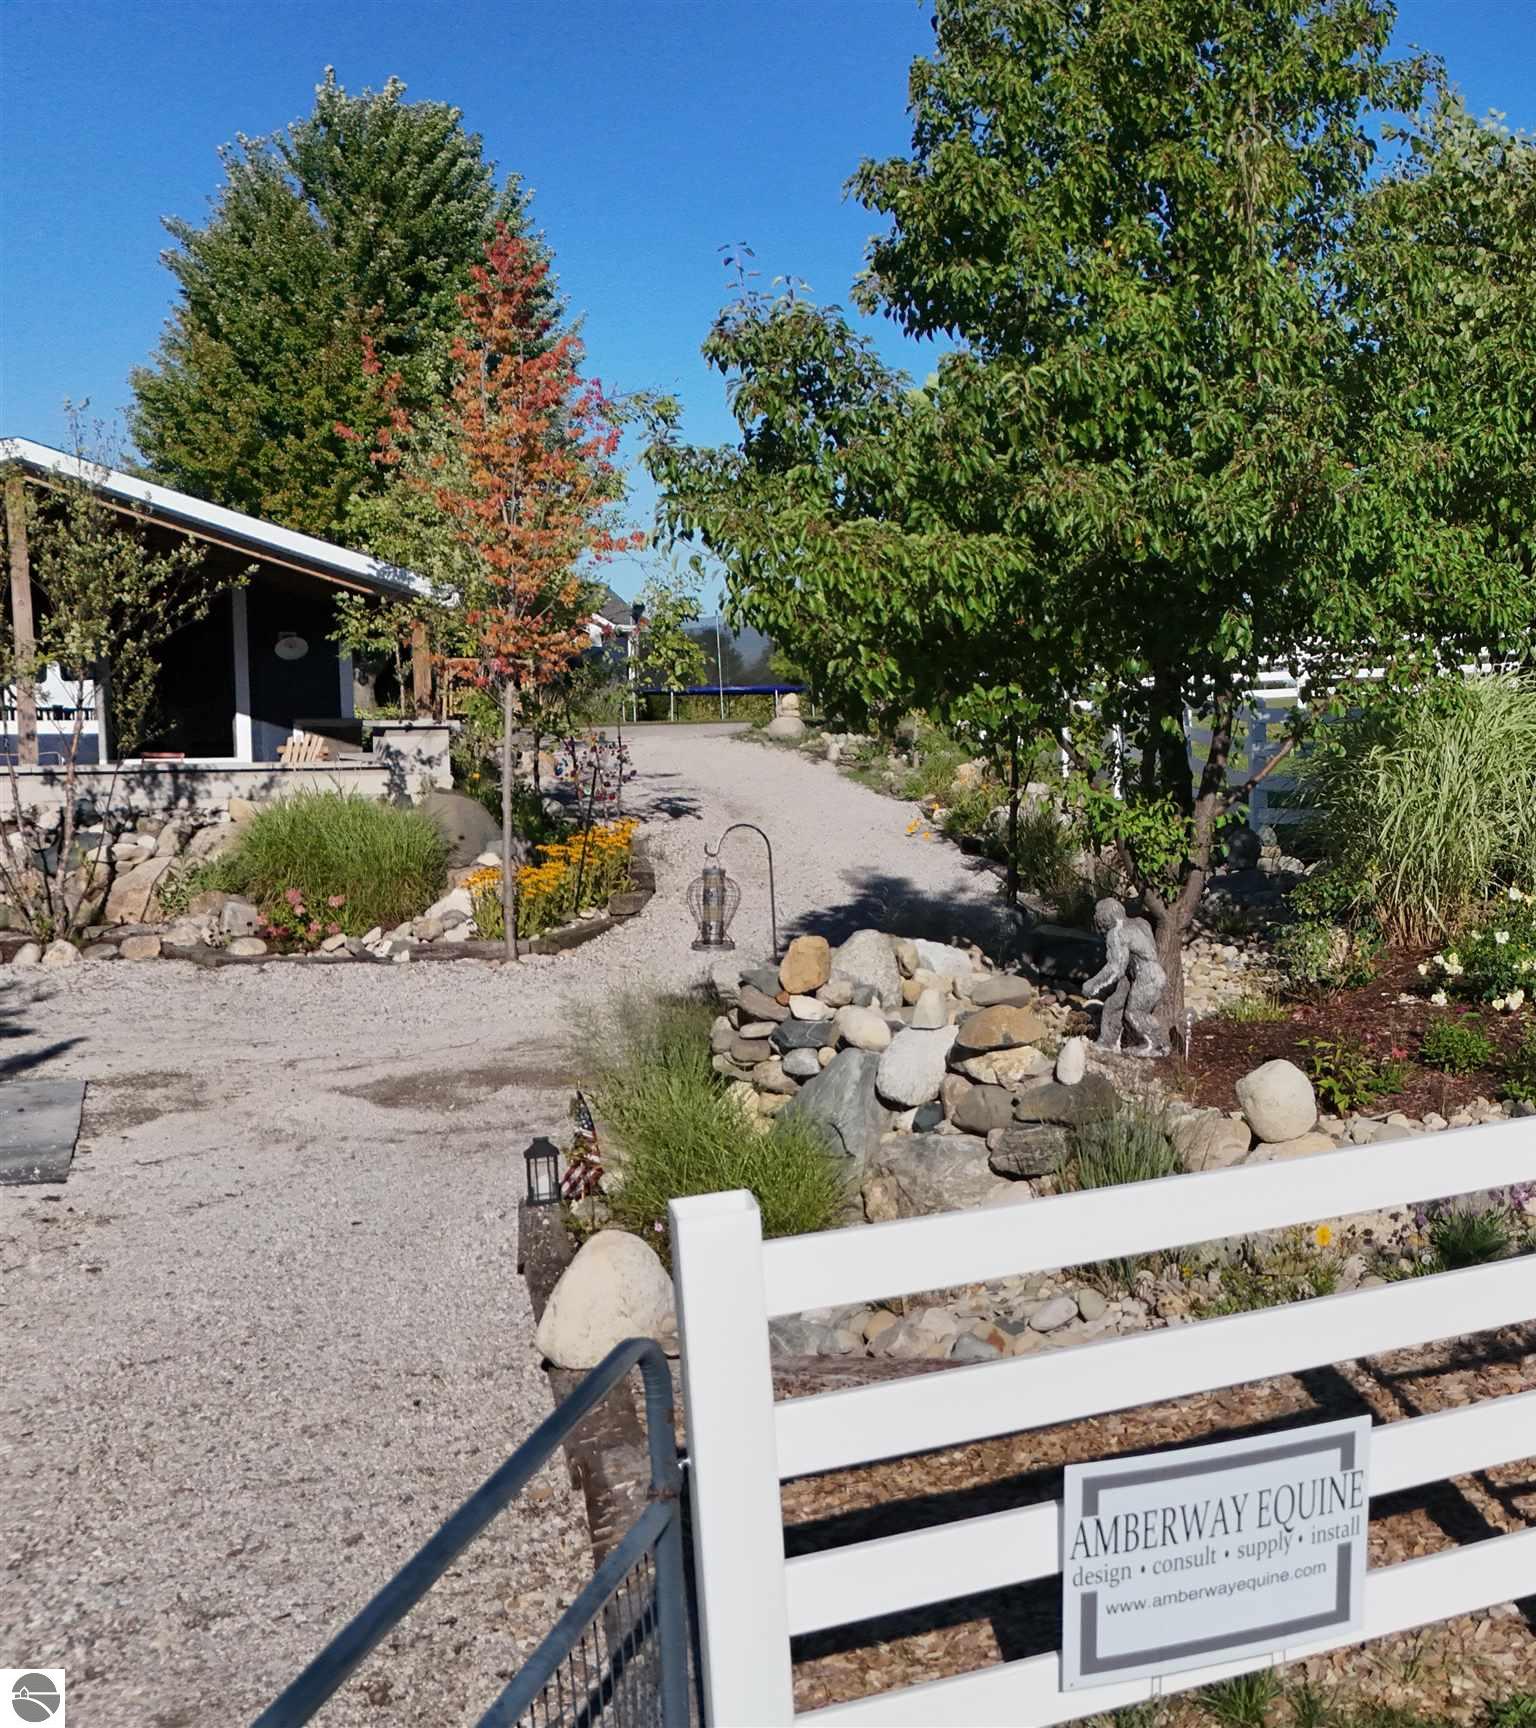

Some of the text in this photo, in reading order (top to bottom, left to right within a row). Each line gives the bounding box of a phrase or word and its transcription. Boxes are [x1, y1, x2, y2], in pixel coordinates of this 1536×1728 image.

[1070, 1469, 1365, 1561] AMBERWAY EQUINE
[1072, 1516, 1361, 1588] design consult supply install
[1105, 1561, 1327, 1615] www.amberwayequine.com
